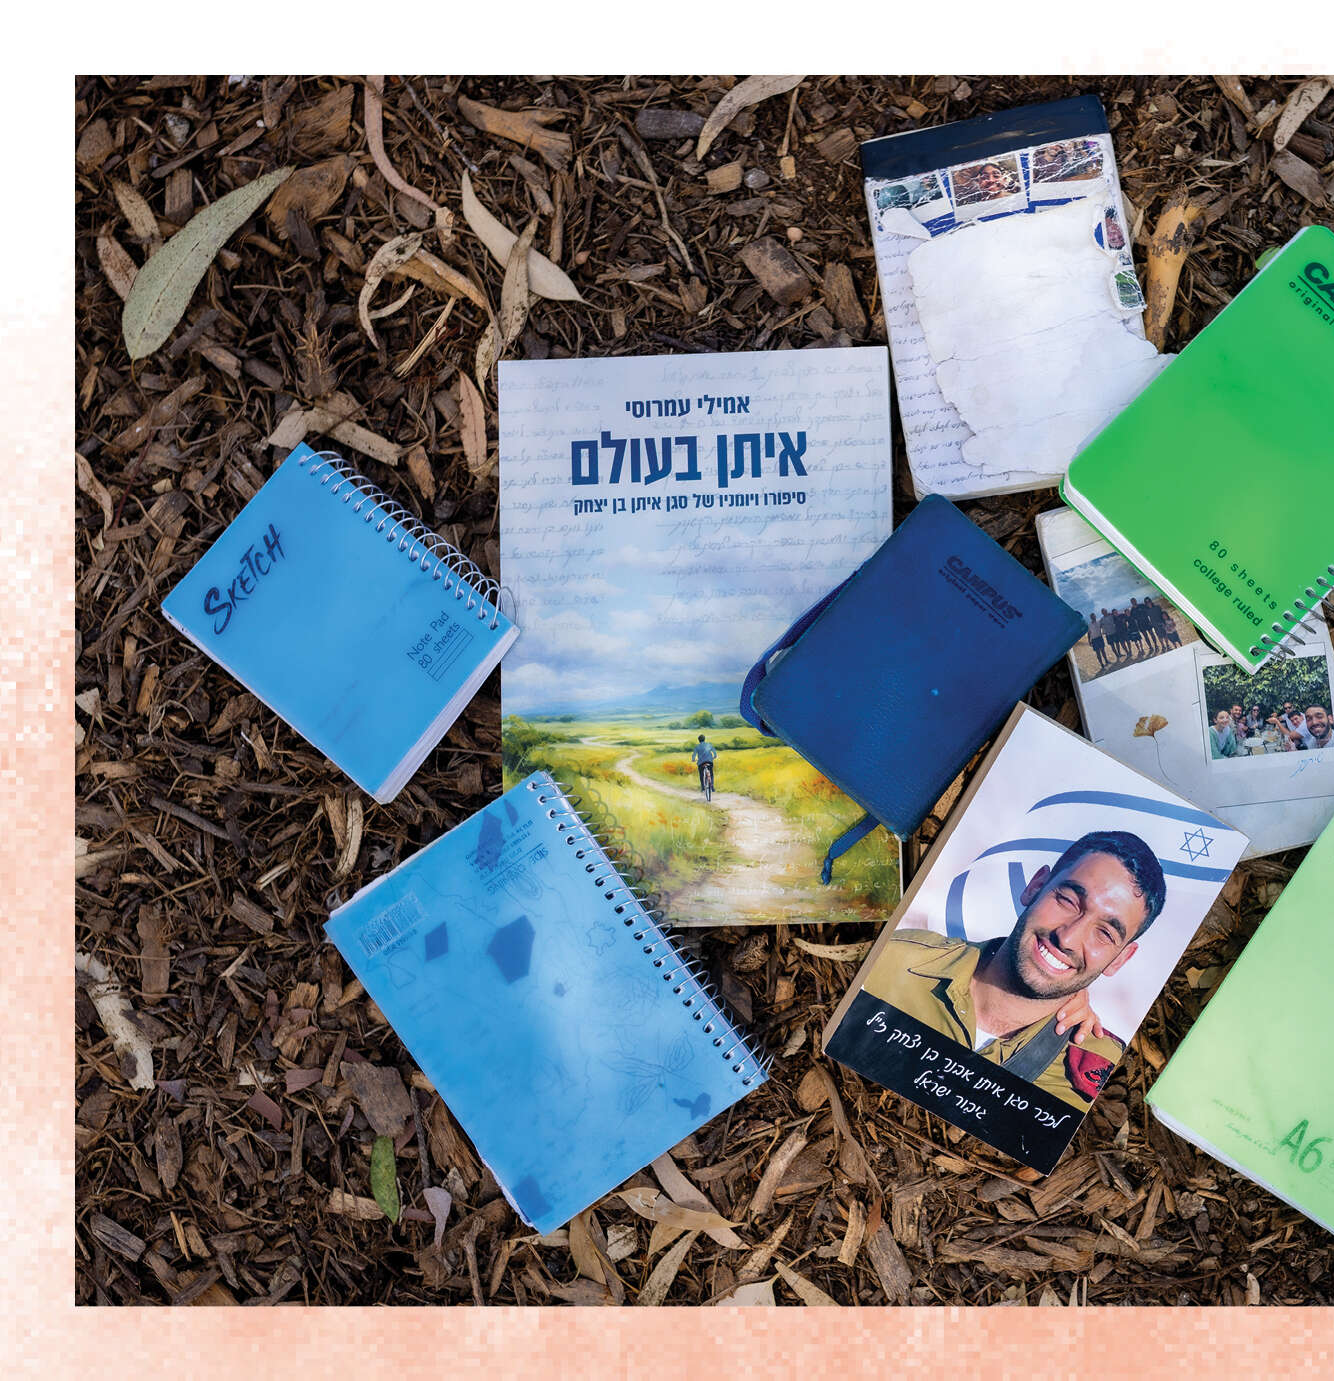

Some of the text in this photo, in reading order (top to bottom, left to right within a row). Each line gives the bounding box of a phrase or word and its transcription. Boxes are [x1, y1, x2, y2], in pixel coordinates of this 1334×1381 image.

[625, 394, 750, 419] אמילי עמרוסי
[571, 431, 808, 489] איתן בעולם
[574, 490, 806, 517] סיפורו ויומניו של סגן איתן בן יצחק
[203, 523, 287, 636] SKETCH
[946, 555, 1023, 620] CAMPUS
[1193, 558, 1263, 628] college ruled
[1209, 539, 1278, 611] 80 sheets
[406, 610, 450, 662] Note Pad
[417, 621, 461, 670] 80 sheets
[886, 1029, 922, 1050] יצחק
[920, 1048, 940, 1062] בן
[944, 1057, 975, 1083] אבנר
[973, 1077, 1006, 1099] איתן
[1004, 1093, 1029, 1111] סגן
[1034, 1107, 1072, 1130] לזכר
[1280, 1119, 1334, 1174] A6
